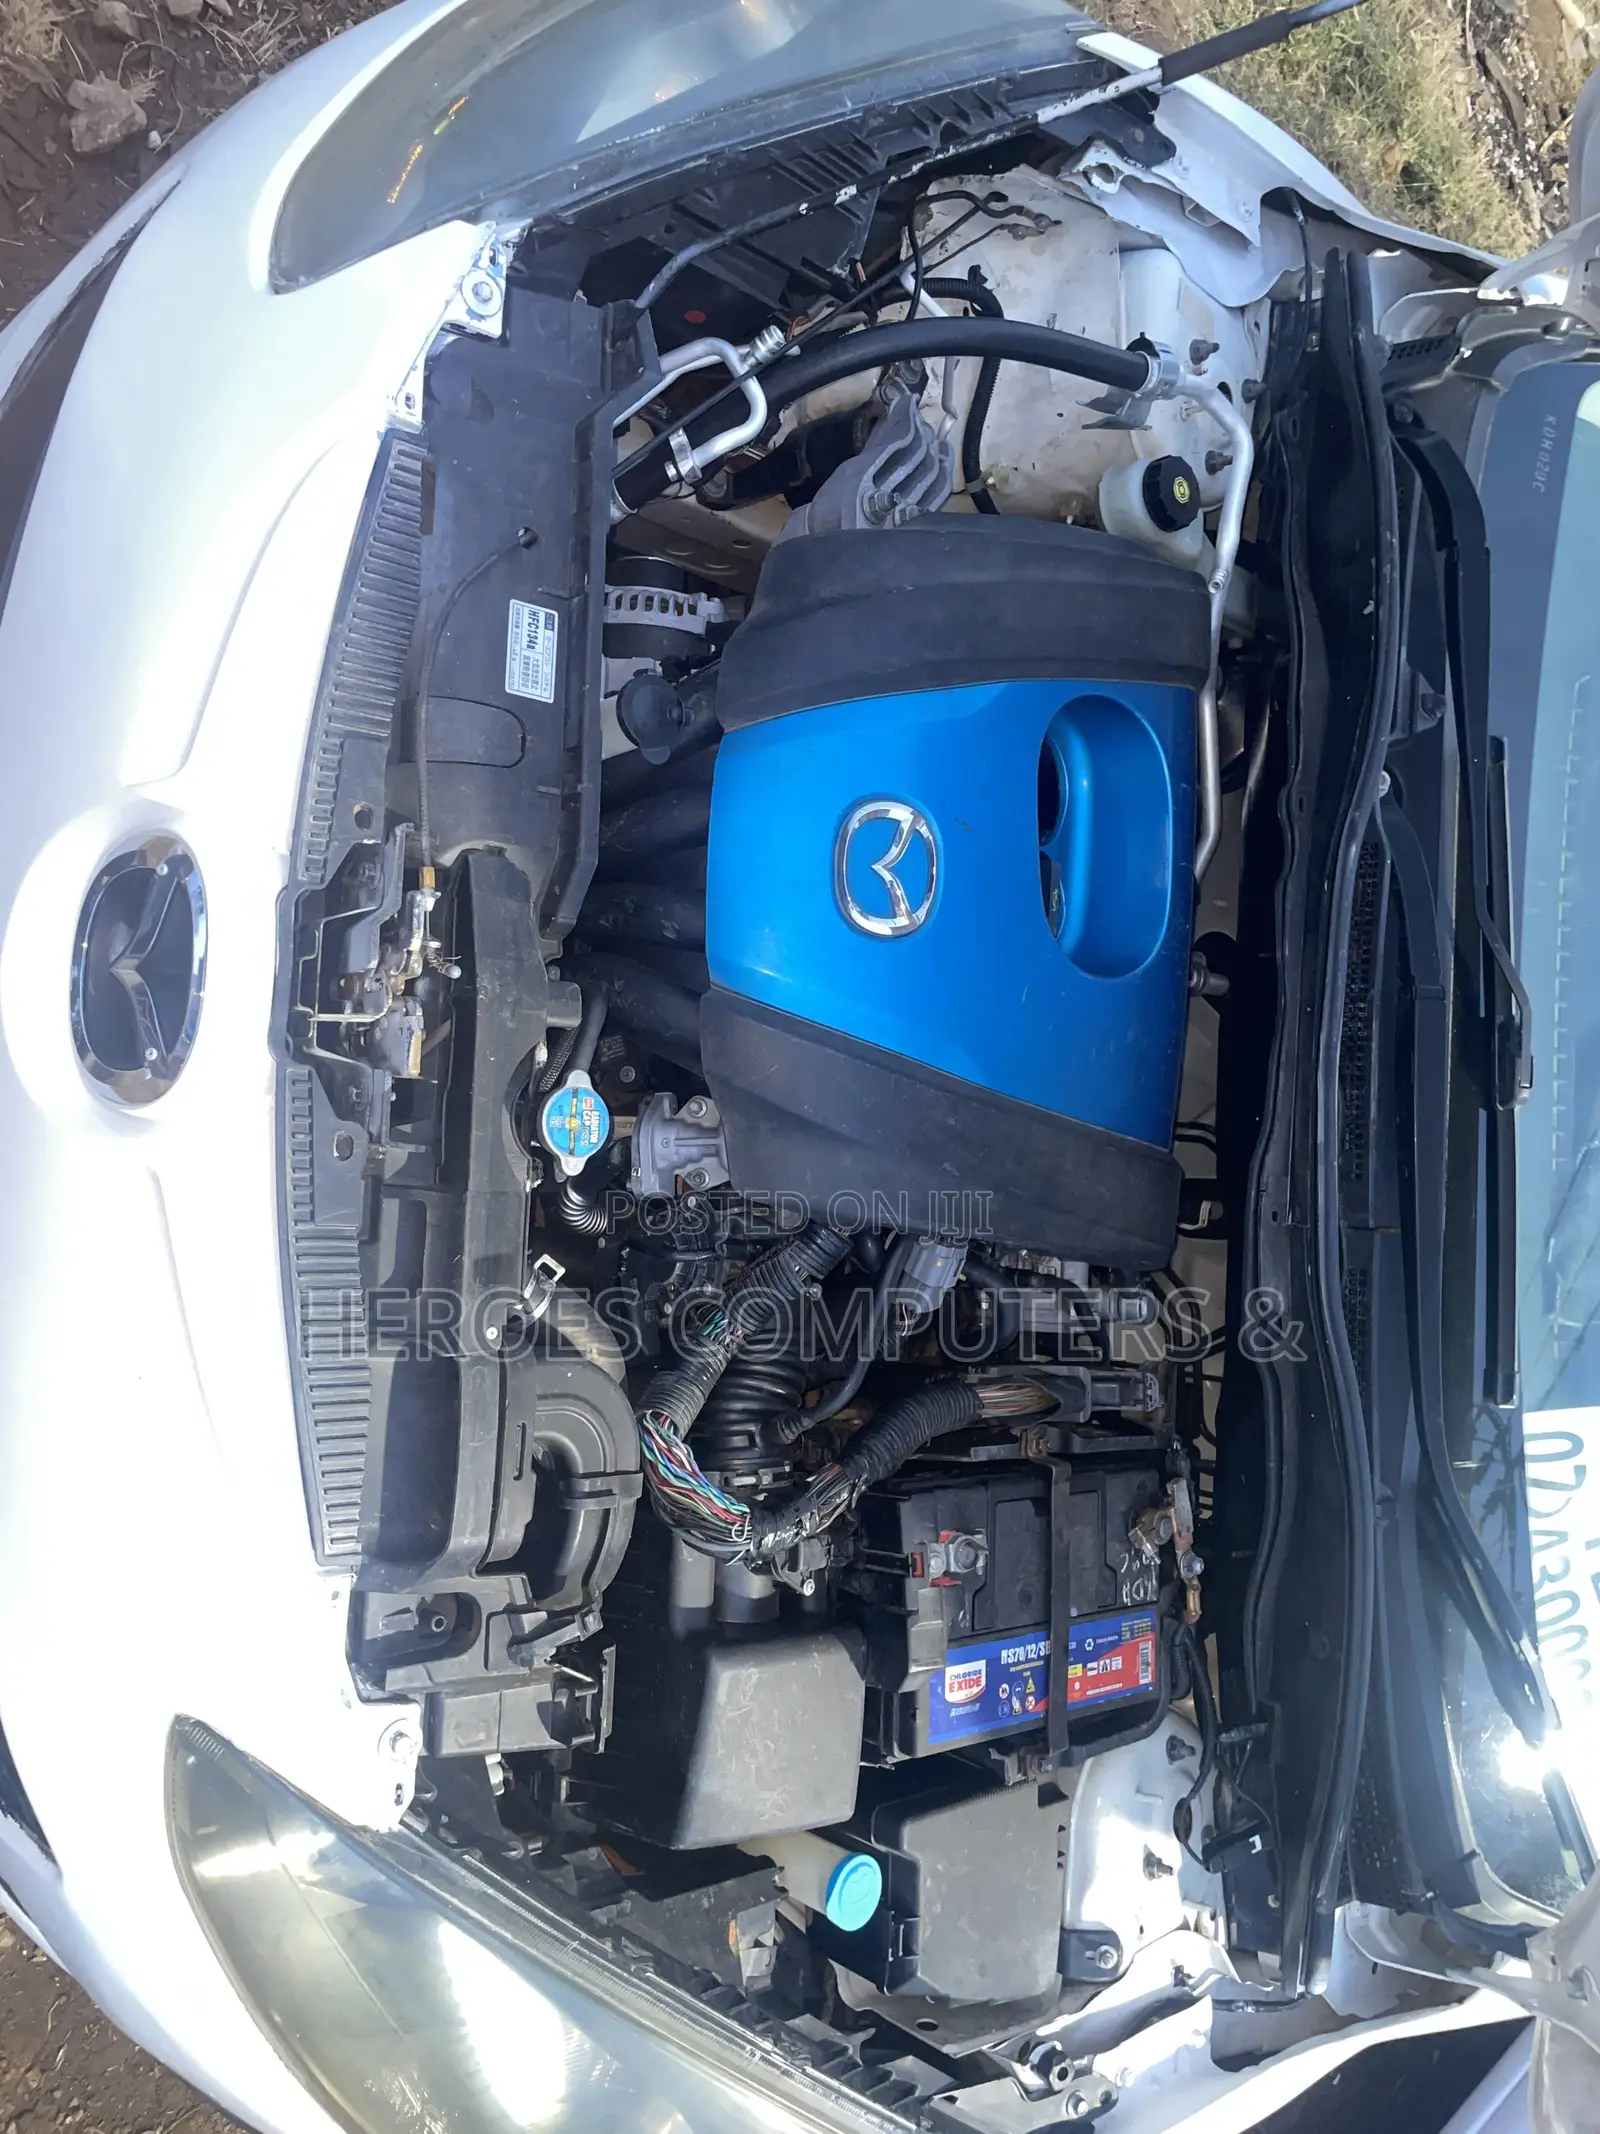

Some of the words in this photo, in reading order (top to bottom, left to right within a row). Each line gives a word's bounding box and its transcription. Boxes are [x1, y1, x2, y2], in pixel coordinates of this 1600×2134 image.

[526, 609, 540, 650] HFC134a
[582, 1110, 592, 1127] CAP
[949, 1675, 983, 1693] EXIDE
